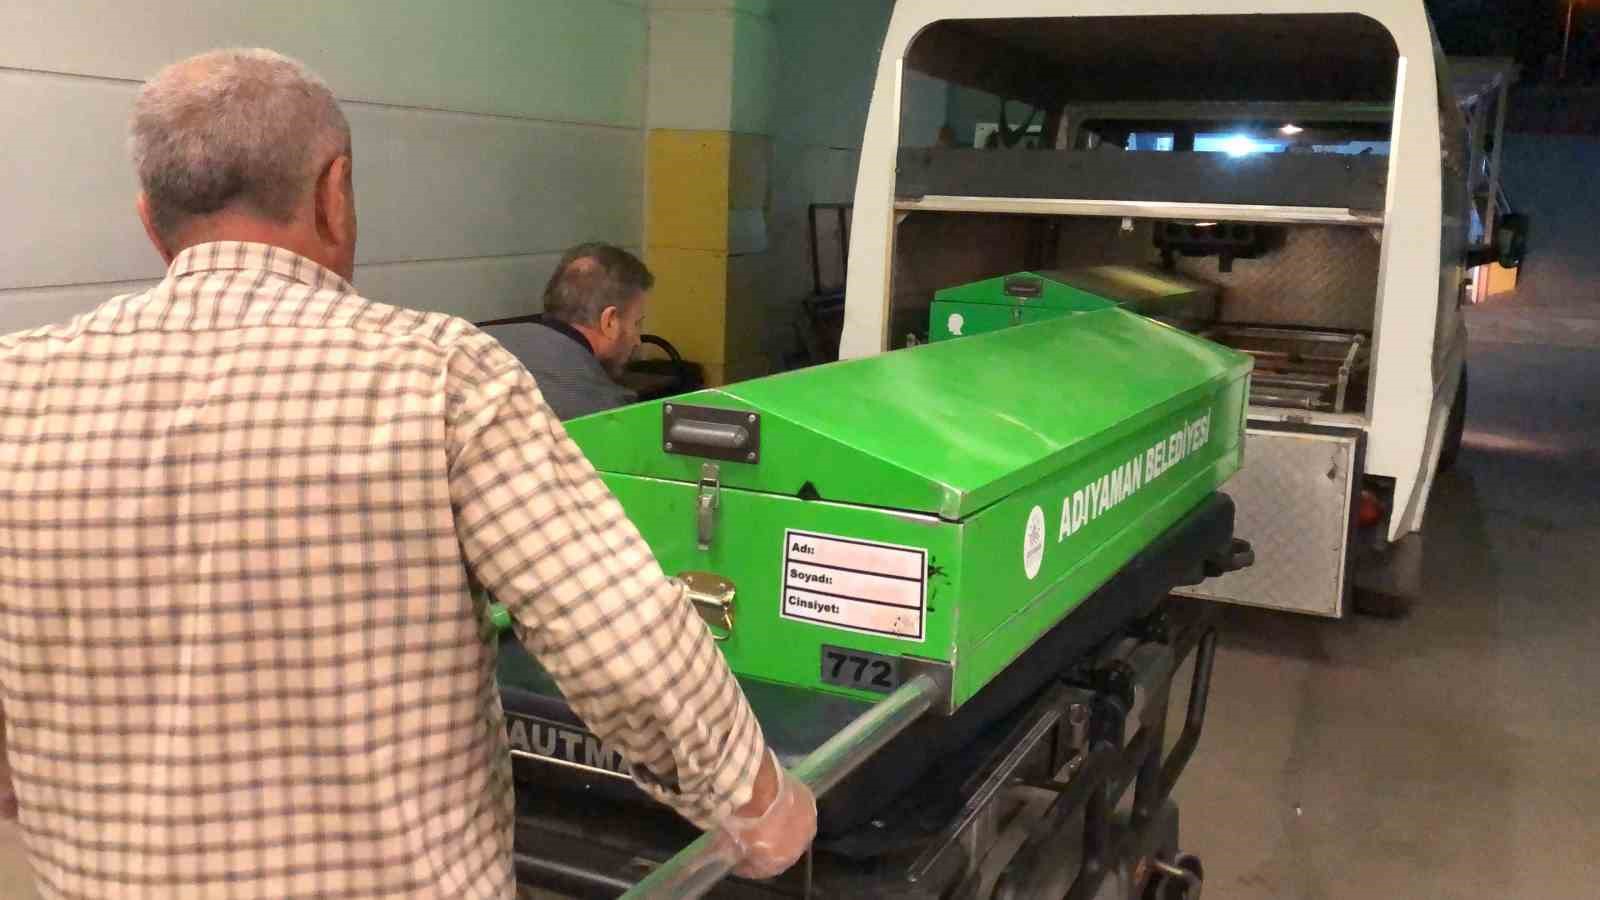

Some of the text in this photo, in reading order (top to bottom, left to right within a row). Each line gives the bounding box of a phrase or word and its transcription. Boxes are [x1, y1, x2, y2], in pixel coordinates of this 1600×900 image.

[1057, 407, 1212, 544] ADIYAMAN BELEDİYESİ
[791, 542, 815, 555] Adı:
[789, 568, 833, 585] Soyadı:
[788, 595, 840, 614] Cinsiyet:
[827, 651, 892, 688] 772
